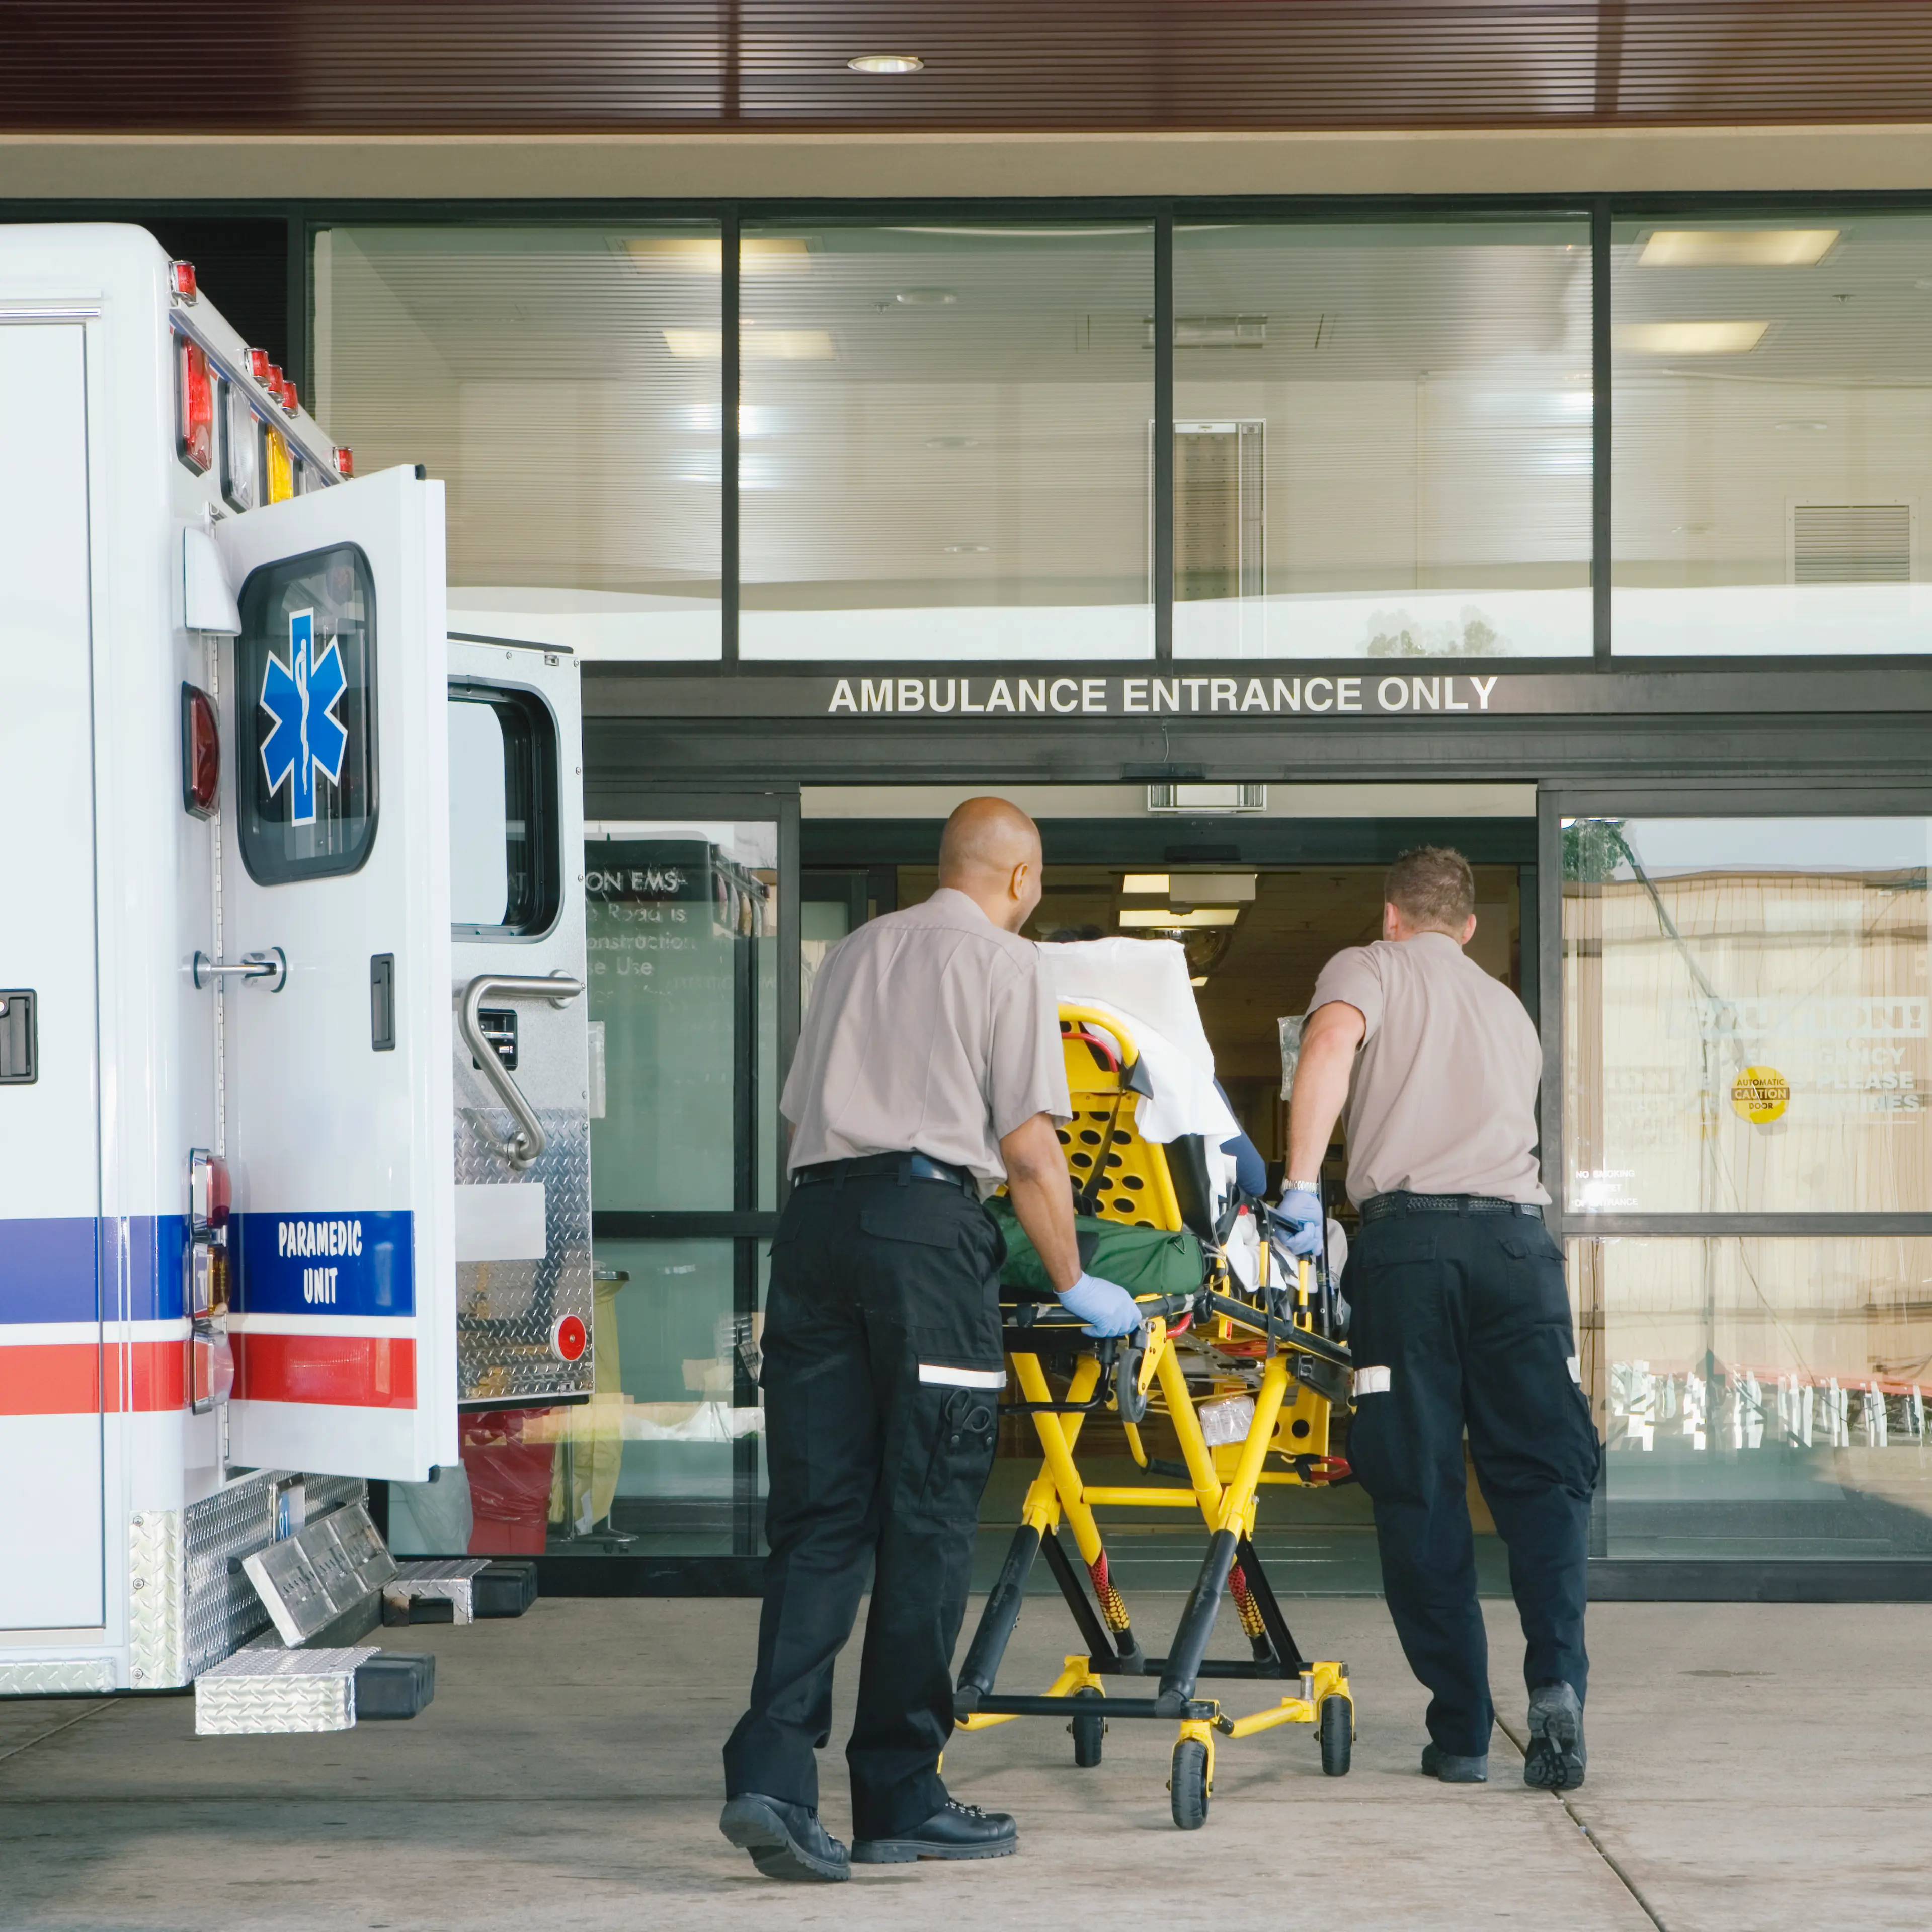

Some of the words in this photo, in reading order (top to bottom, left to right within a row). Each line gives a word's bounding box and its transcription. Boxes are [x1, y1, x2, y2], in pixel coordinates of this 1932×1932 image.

[828, 677, 1107, 714] AMBULANCE
[1123, 676, 1362, 713] ENTRANCE
[1377, 675, 1499, 713] ONLY
[616, 956, 654, 975] Use
[1737, 1078, 1785, 1086] AUTOMATIC
[1817, 1071, 1914, 1089] PLEASE
[1735, 1089, 1786, 1099] CAUTION
[1575, 1170, 1589, 1179] NO
[1592, 1169, 1635, 1179] SMOKING
[1592, 1198, 1639, 1207] NTRANCE
[278, 1220, 362, 1258] PARAMEDIC
[303, 1267, 338, 1304] UNIT
